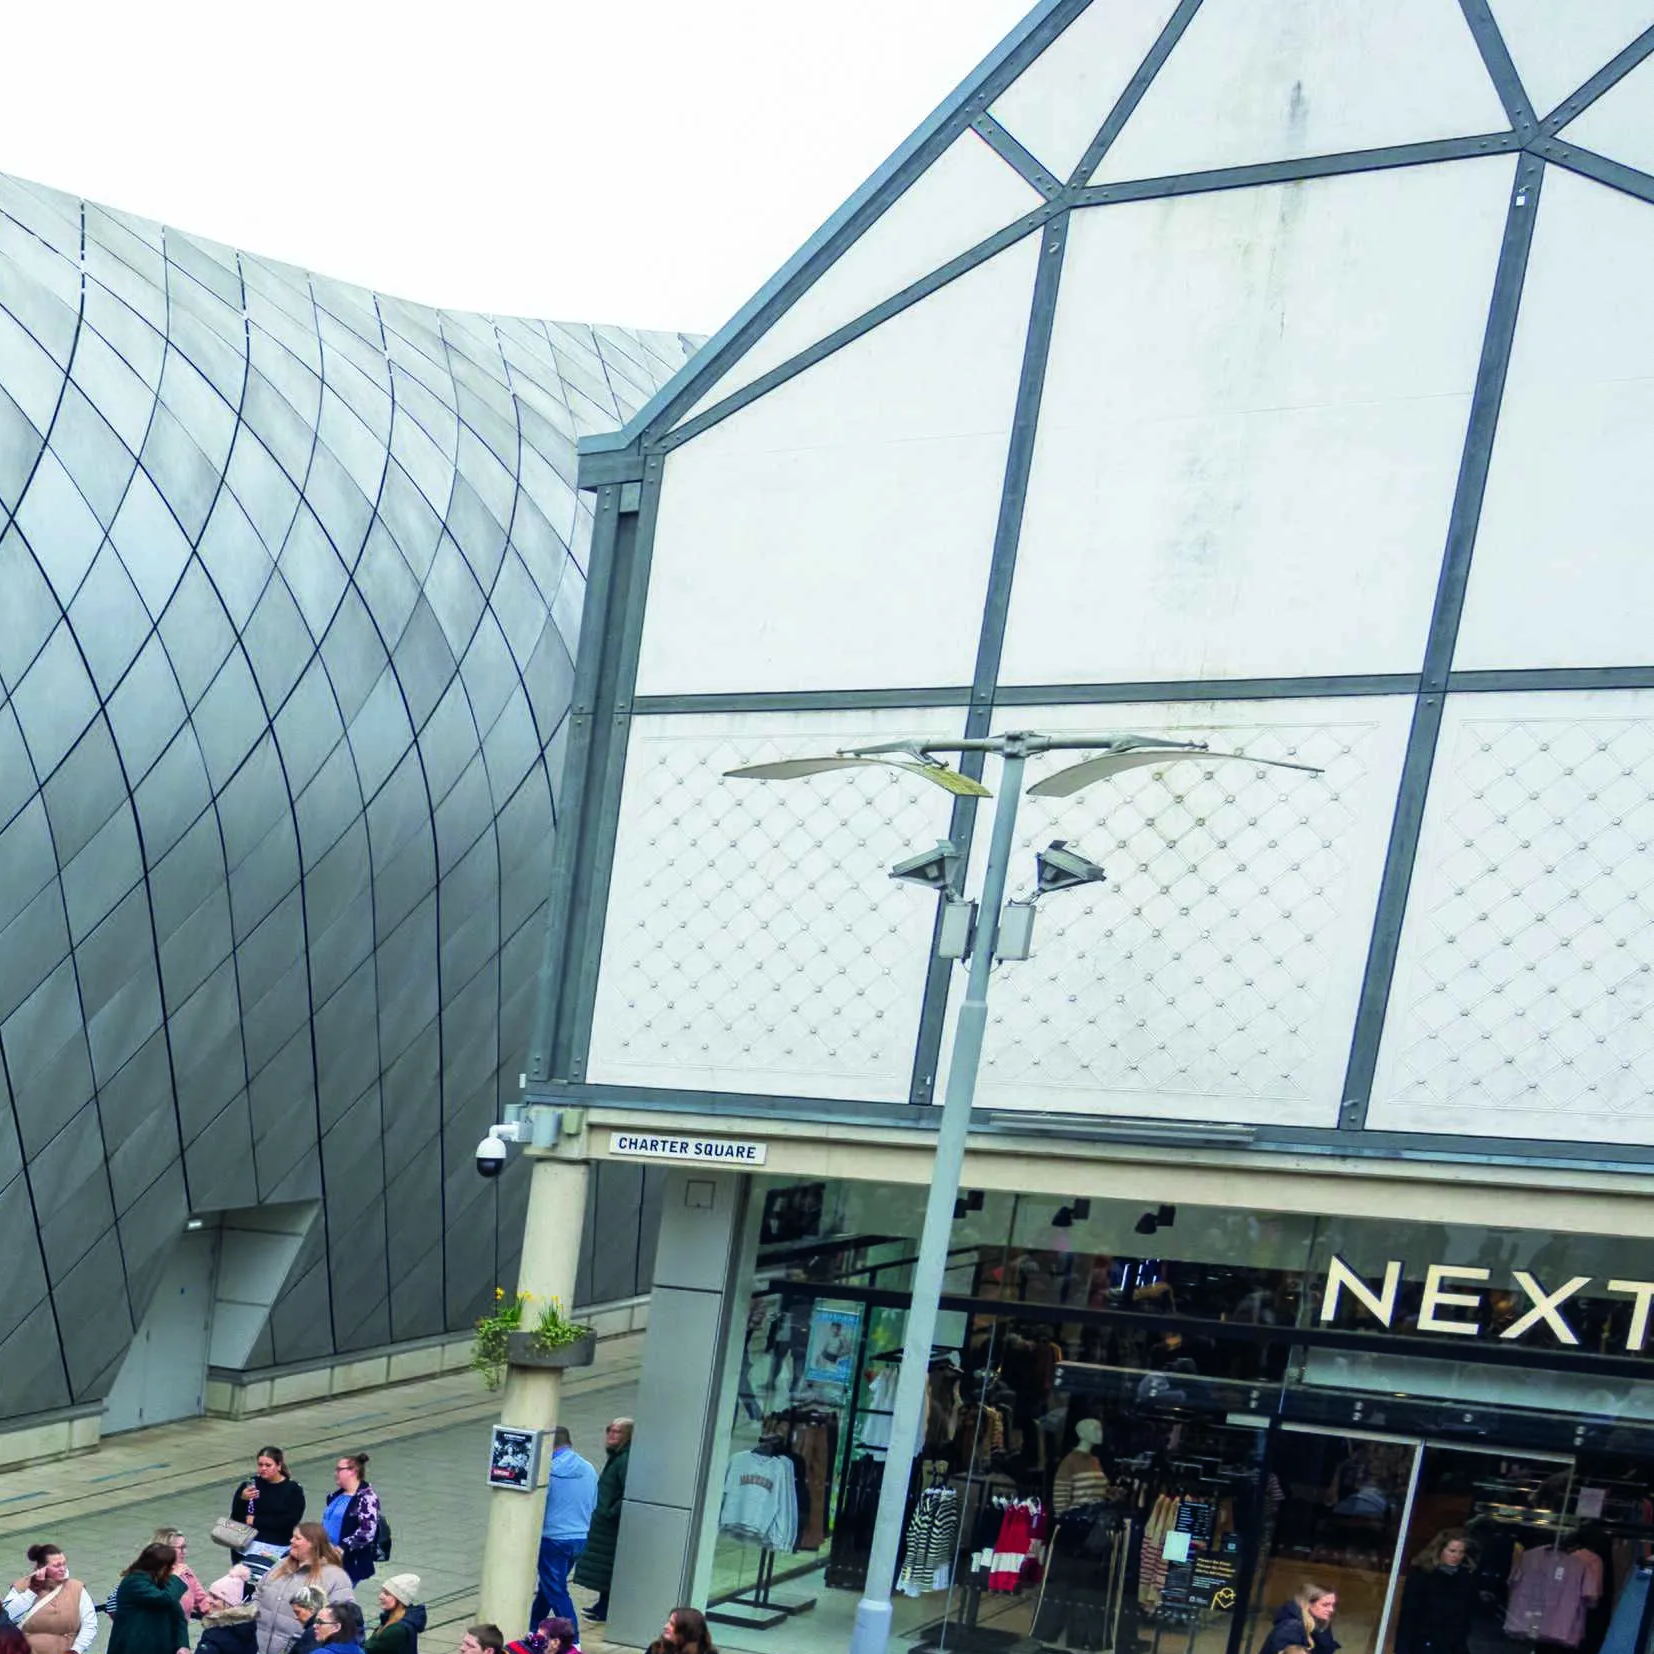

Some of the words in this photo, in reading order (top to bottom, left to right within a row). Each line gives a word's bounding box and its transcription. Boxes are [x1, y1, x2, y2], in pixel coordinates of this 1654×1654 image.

[618, 1136, 689, 1154] CHARTER
[694, 1142, 757, 1159] SQUARE
[1319, 1253, 1654, 1352] NEXT
